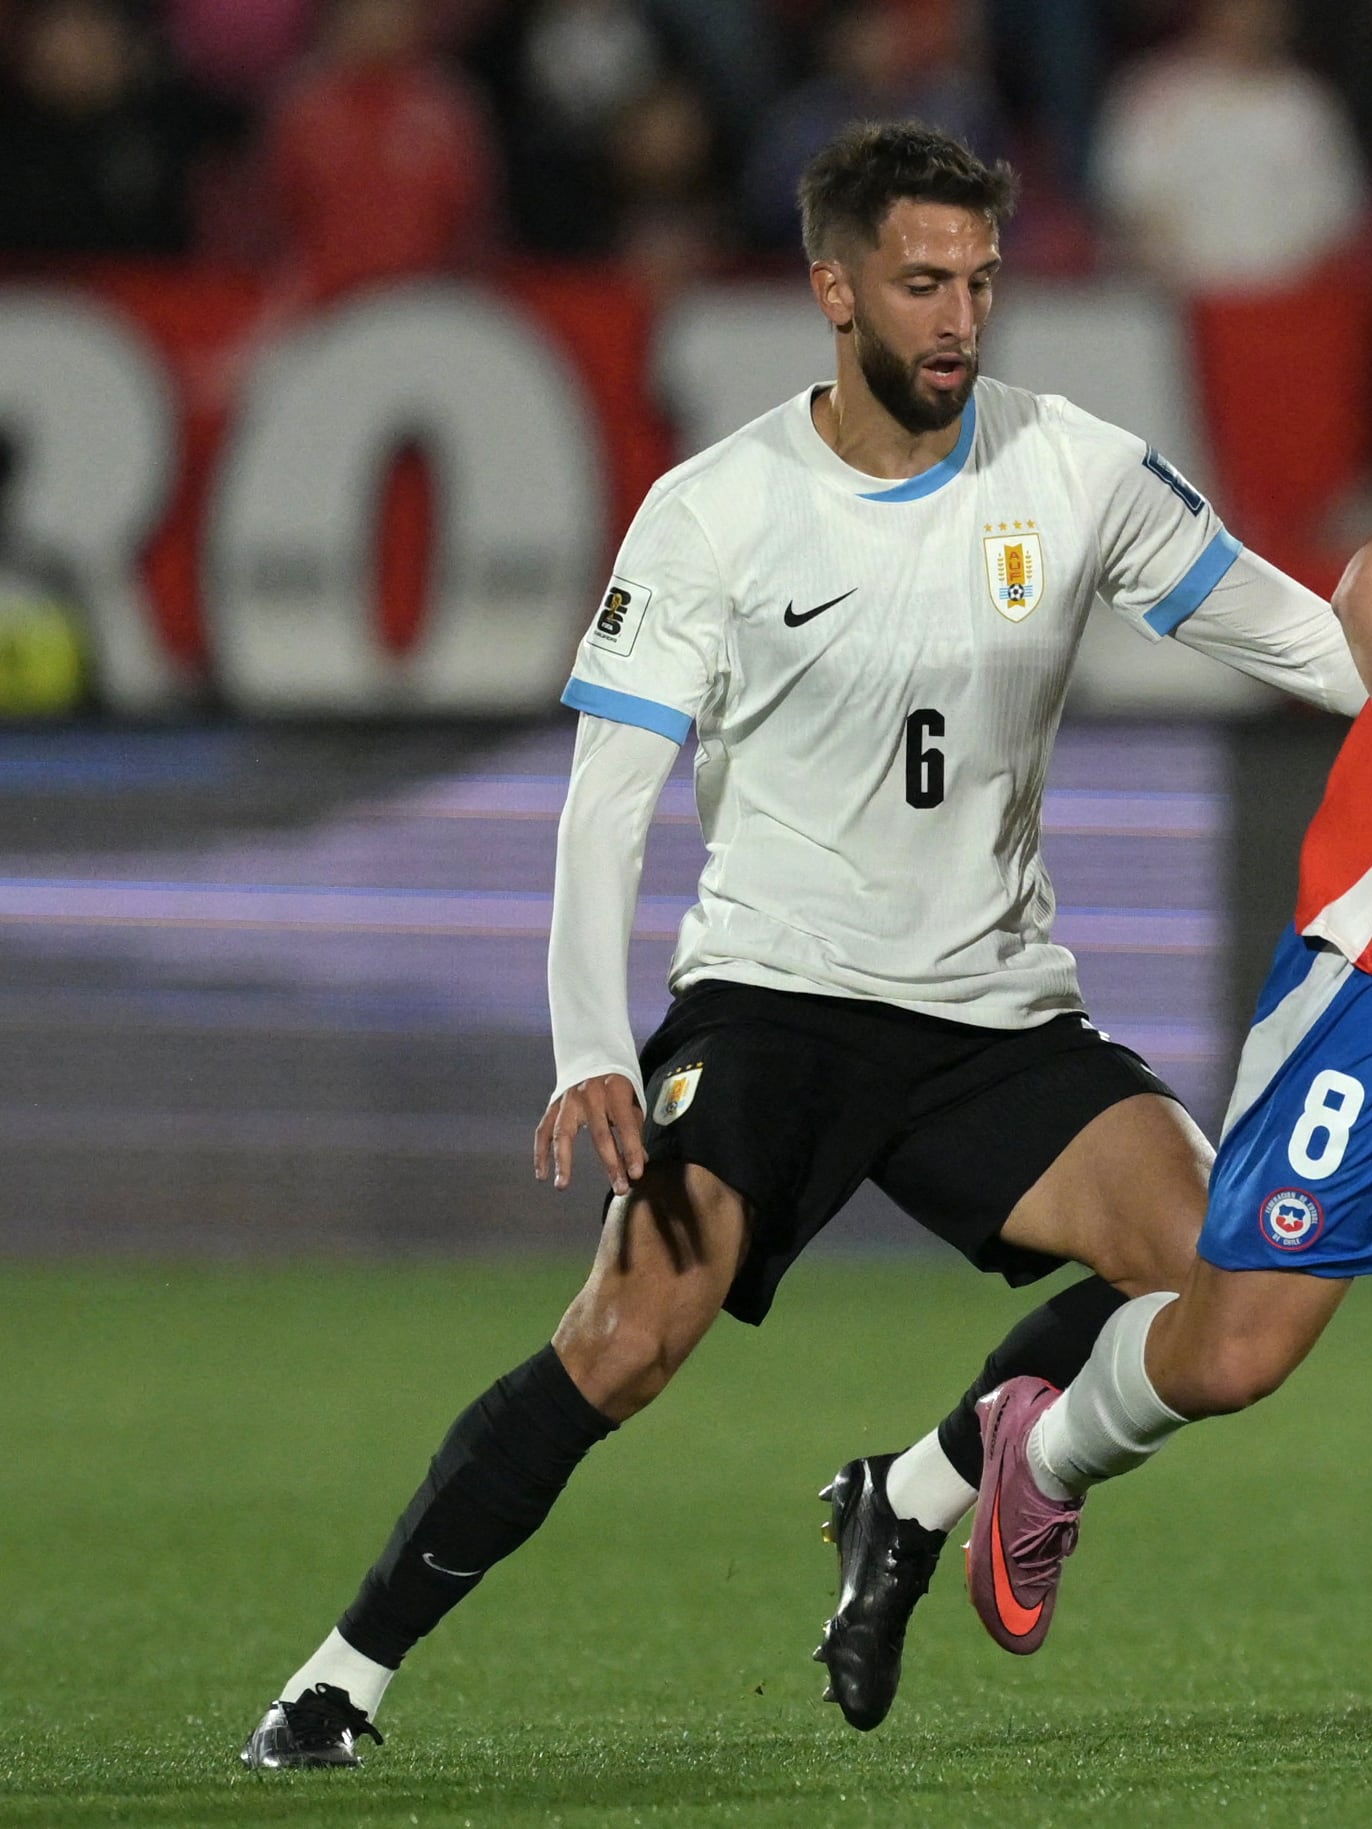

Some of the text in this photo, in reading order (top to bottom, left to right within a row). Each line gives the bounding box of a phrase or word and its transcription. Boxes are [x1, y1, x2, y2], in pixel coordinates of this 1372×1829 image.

[1008, 551, 1021, 582] AUF
[906, 708, 945, 809] 6
[1288, 1069, 1365, 1180] 8
